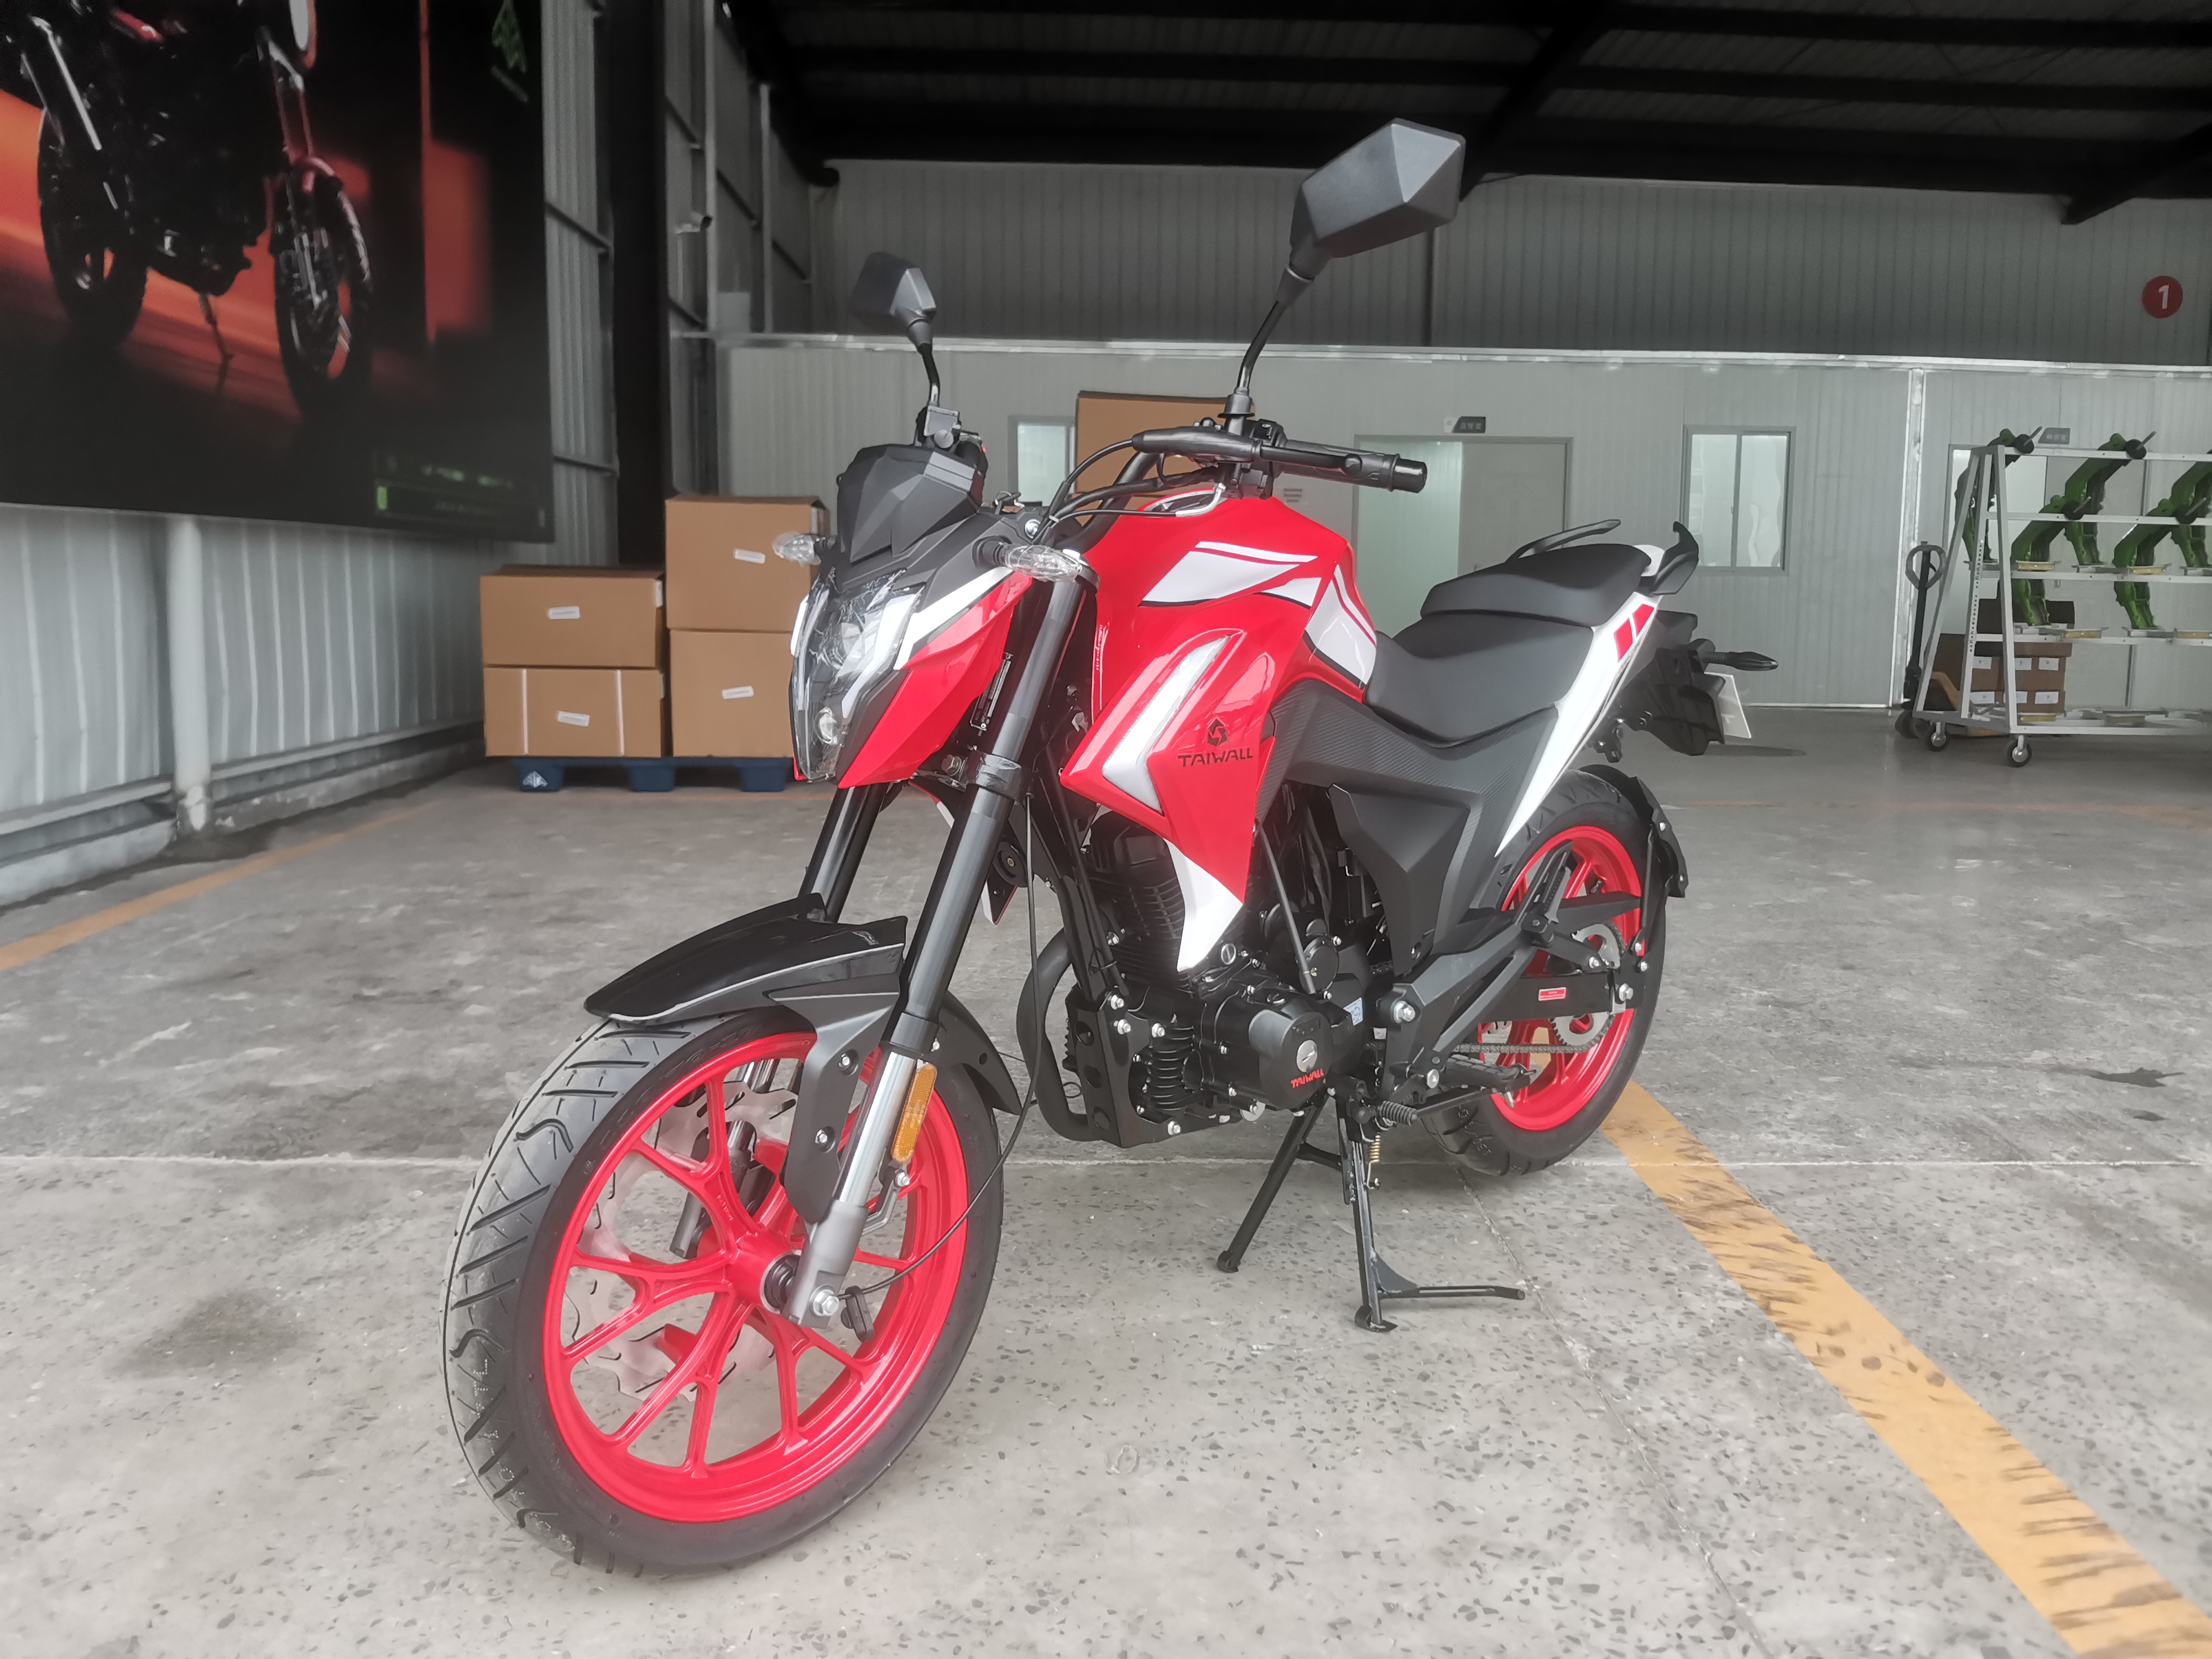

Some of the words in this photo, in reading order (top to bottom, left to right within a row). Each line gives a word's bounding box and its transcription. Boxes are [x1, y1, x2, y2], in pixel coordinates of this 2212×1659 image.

[2158, 284, 2169, 310] 1
[1178, 748, 1253, 767] TAIWALL
[1290, 1068, 1324, 1089] TAIWALL
